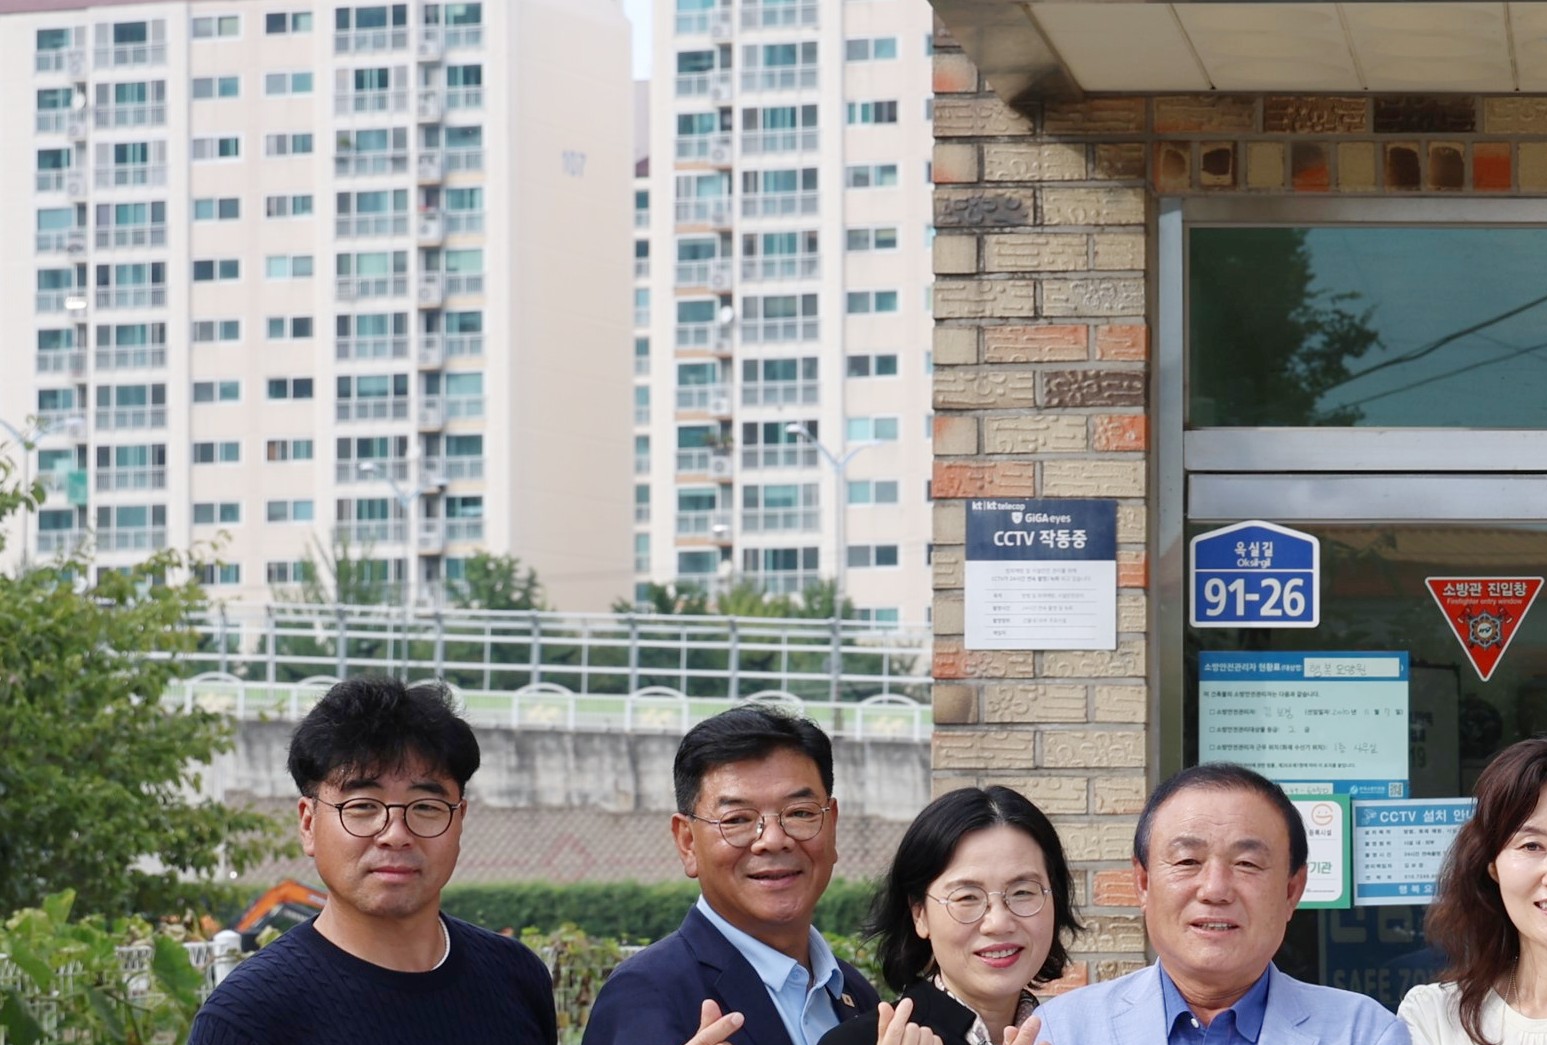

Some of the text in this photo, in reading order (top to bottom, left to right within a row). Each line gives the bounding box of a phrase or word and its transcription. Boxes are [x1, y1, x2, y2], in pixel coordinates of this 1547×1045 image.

[994, 529, 1088, 549] CCTV 작동중
[1234, 541, 1273, 557] 옥실길
[1204, 577, 1305, 617] 91-26
[1442, 581, 1527, 597] 소방관 진입창
[1380, 811, 1417, 823] CCTV
[1423, 809, 1447, 823] 설치
[1307, 861, 1332, 875] 기관
